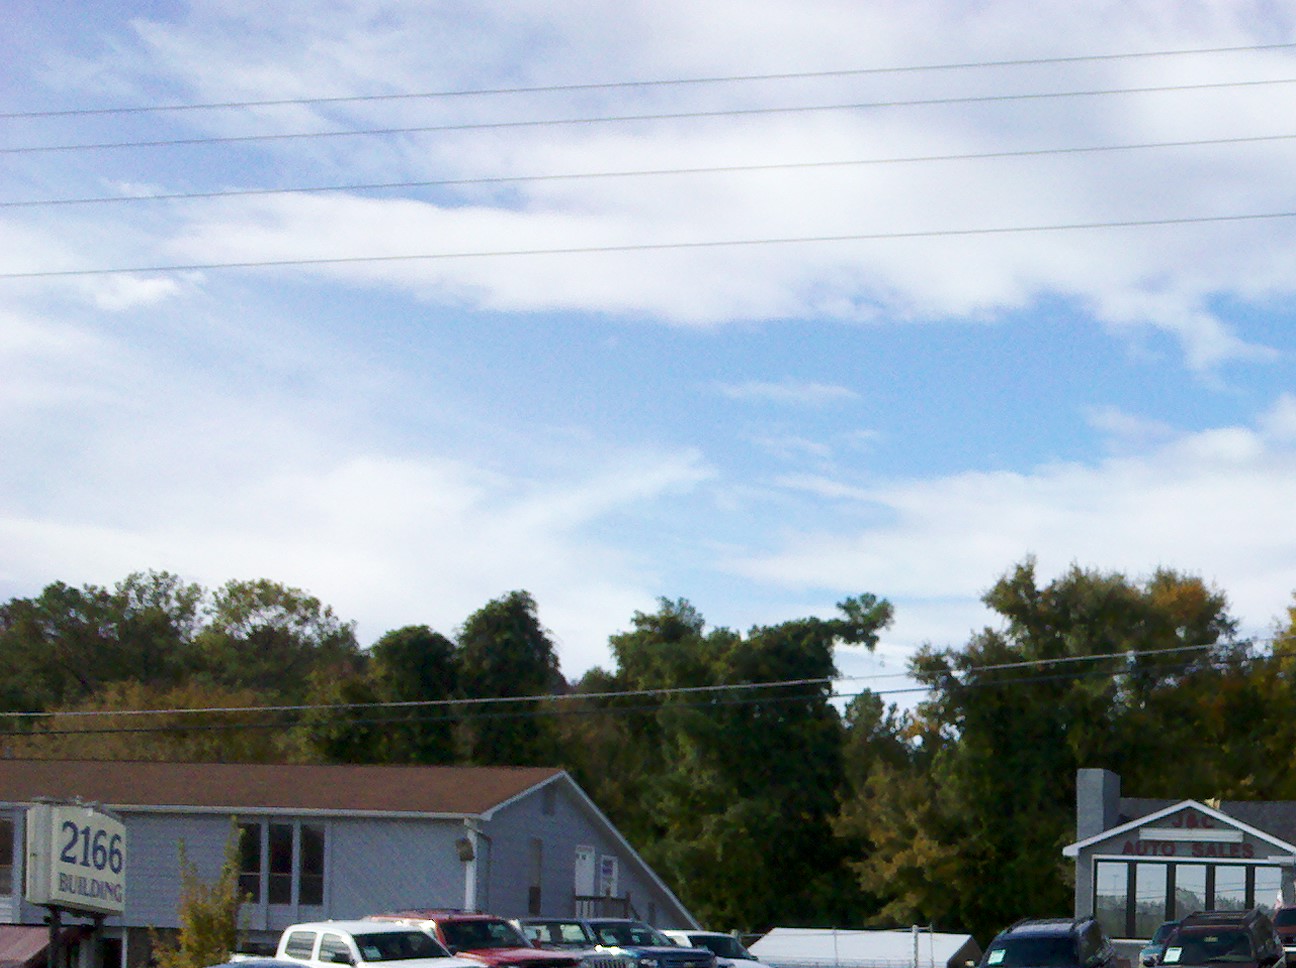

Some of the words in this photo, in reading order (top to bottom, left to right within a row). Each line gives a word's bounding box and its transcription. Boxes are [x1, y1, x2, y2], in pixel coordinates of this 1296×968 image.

[60, 820, 123, 875] 2166
[1121, 840, 1177, 856] AUTO
[1191, 842, 1255, 858] SALES
[58, 871, 123, 903] BUILDING
